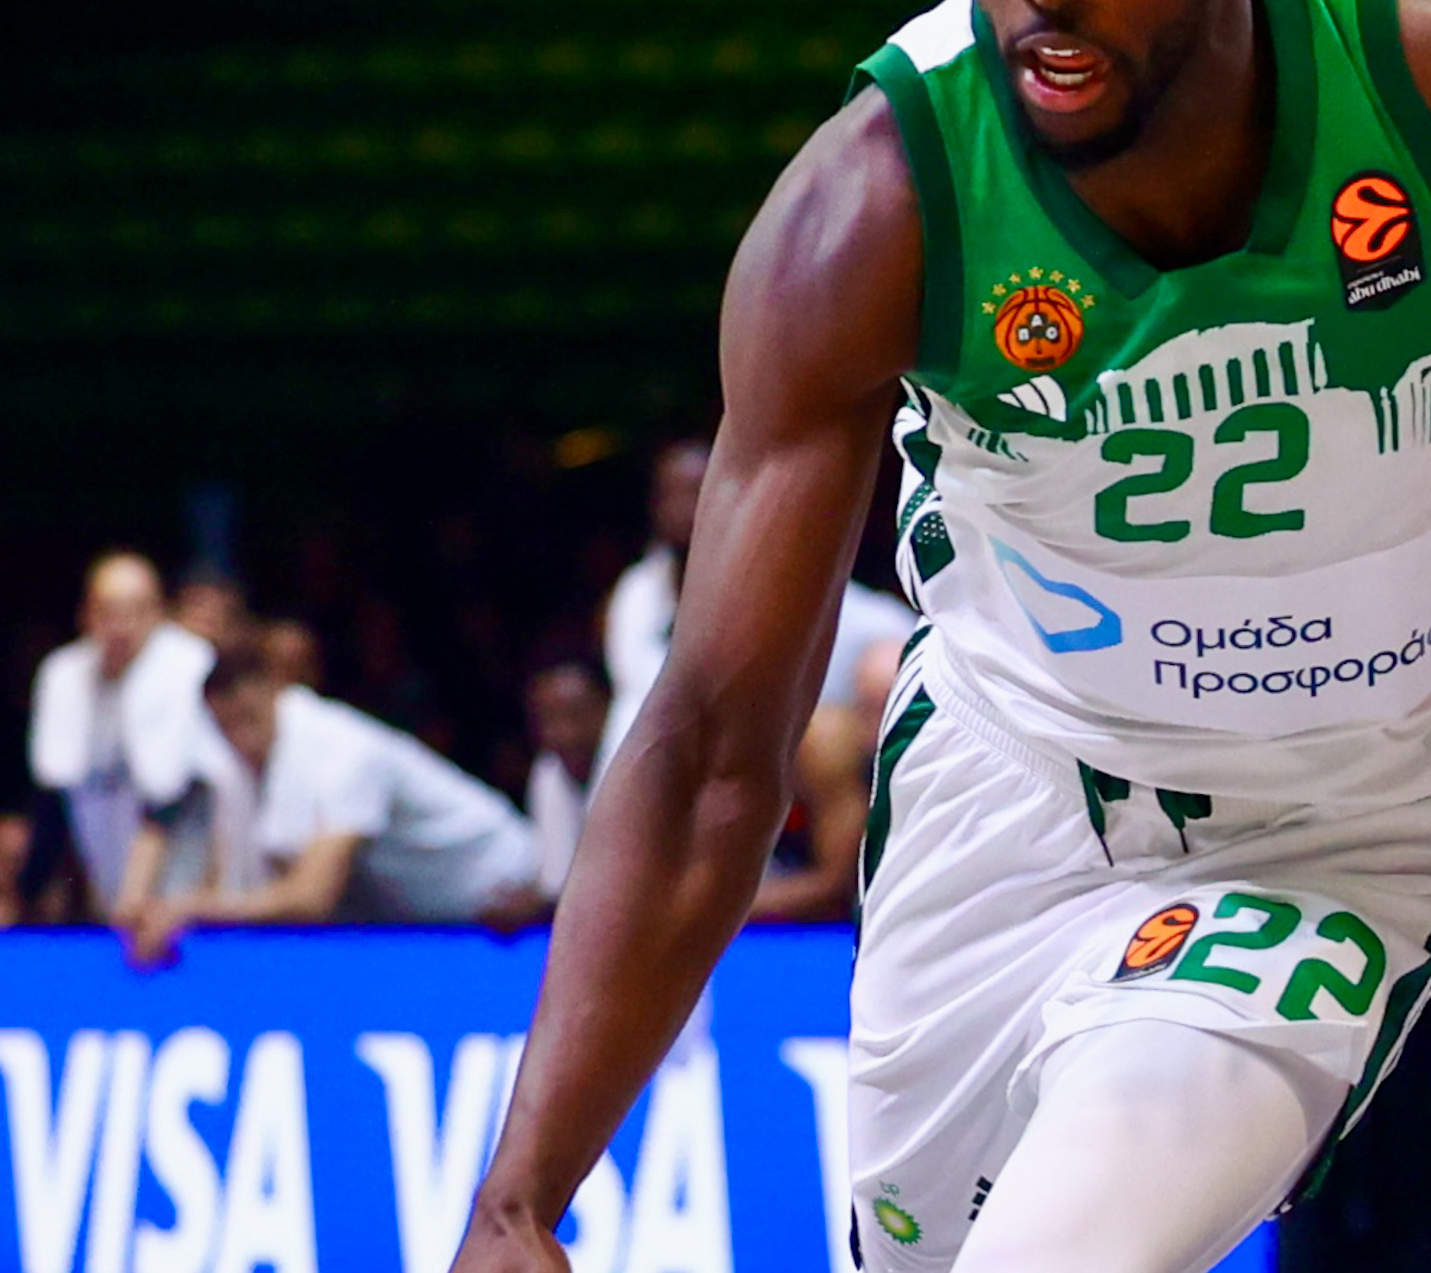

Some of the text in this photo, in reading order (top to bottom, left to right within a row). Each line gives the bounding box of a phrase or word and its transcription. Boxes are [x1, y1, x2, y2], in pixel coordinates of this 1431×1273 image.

[1094, 401, 1311, 543] 22
[1150, 616, 1333, 658] Ομάδα
[1168, 892, 1387, 1021] 22
